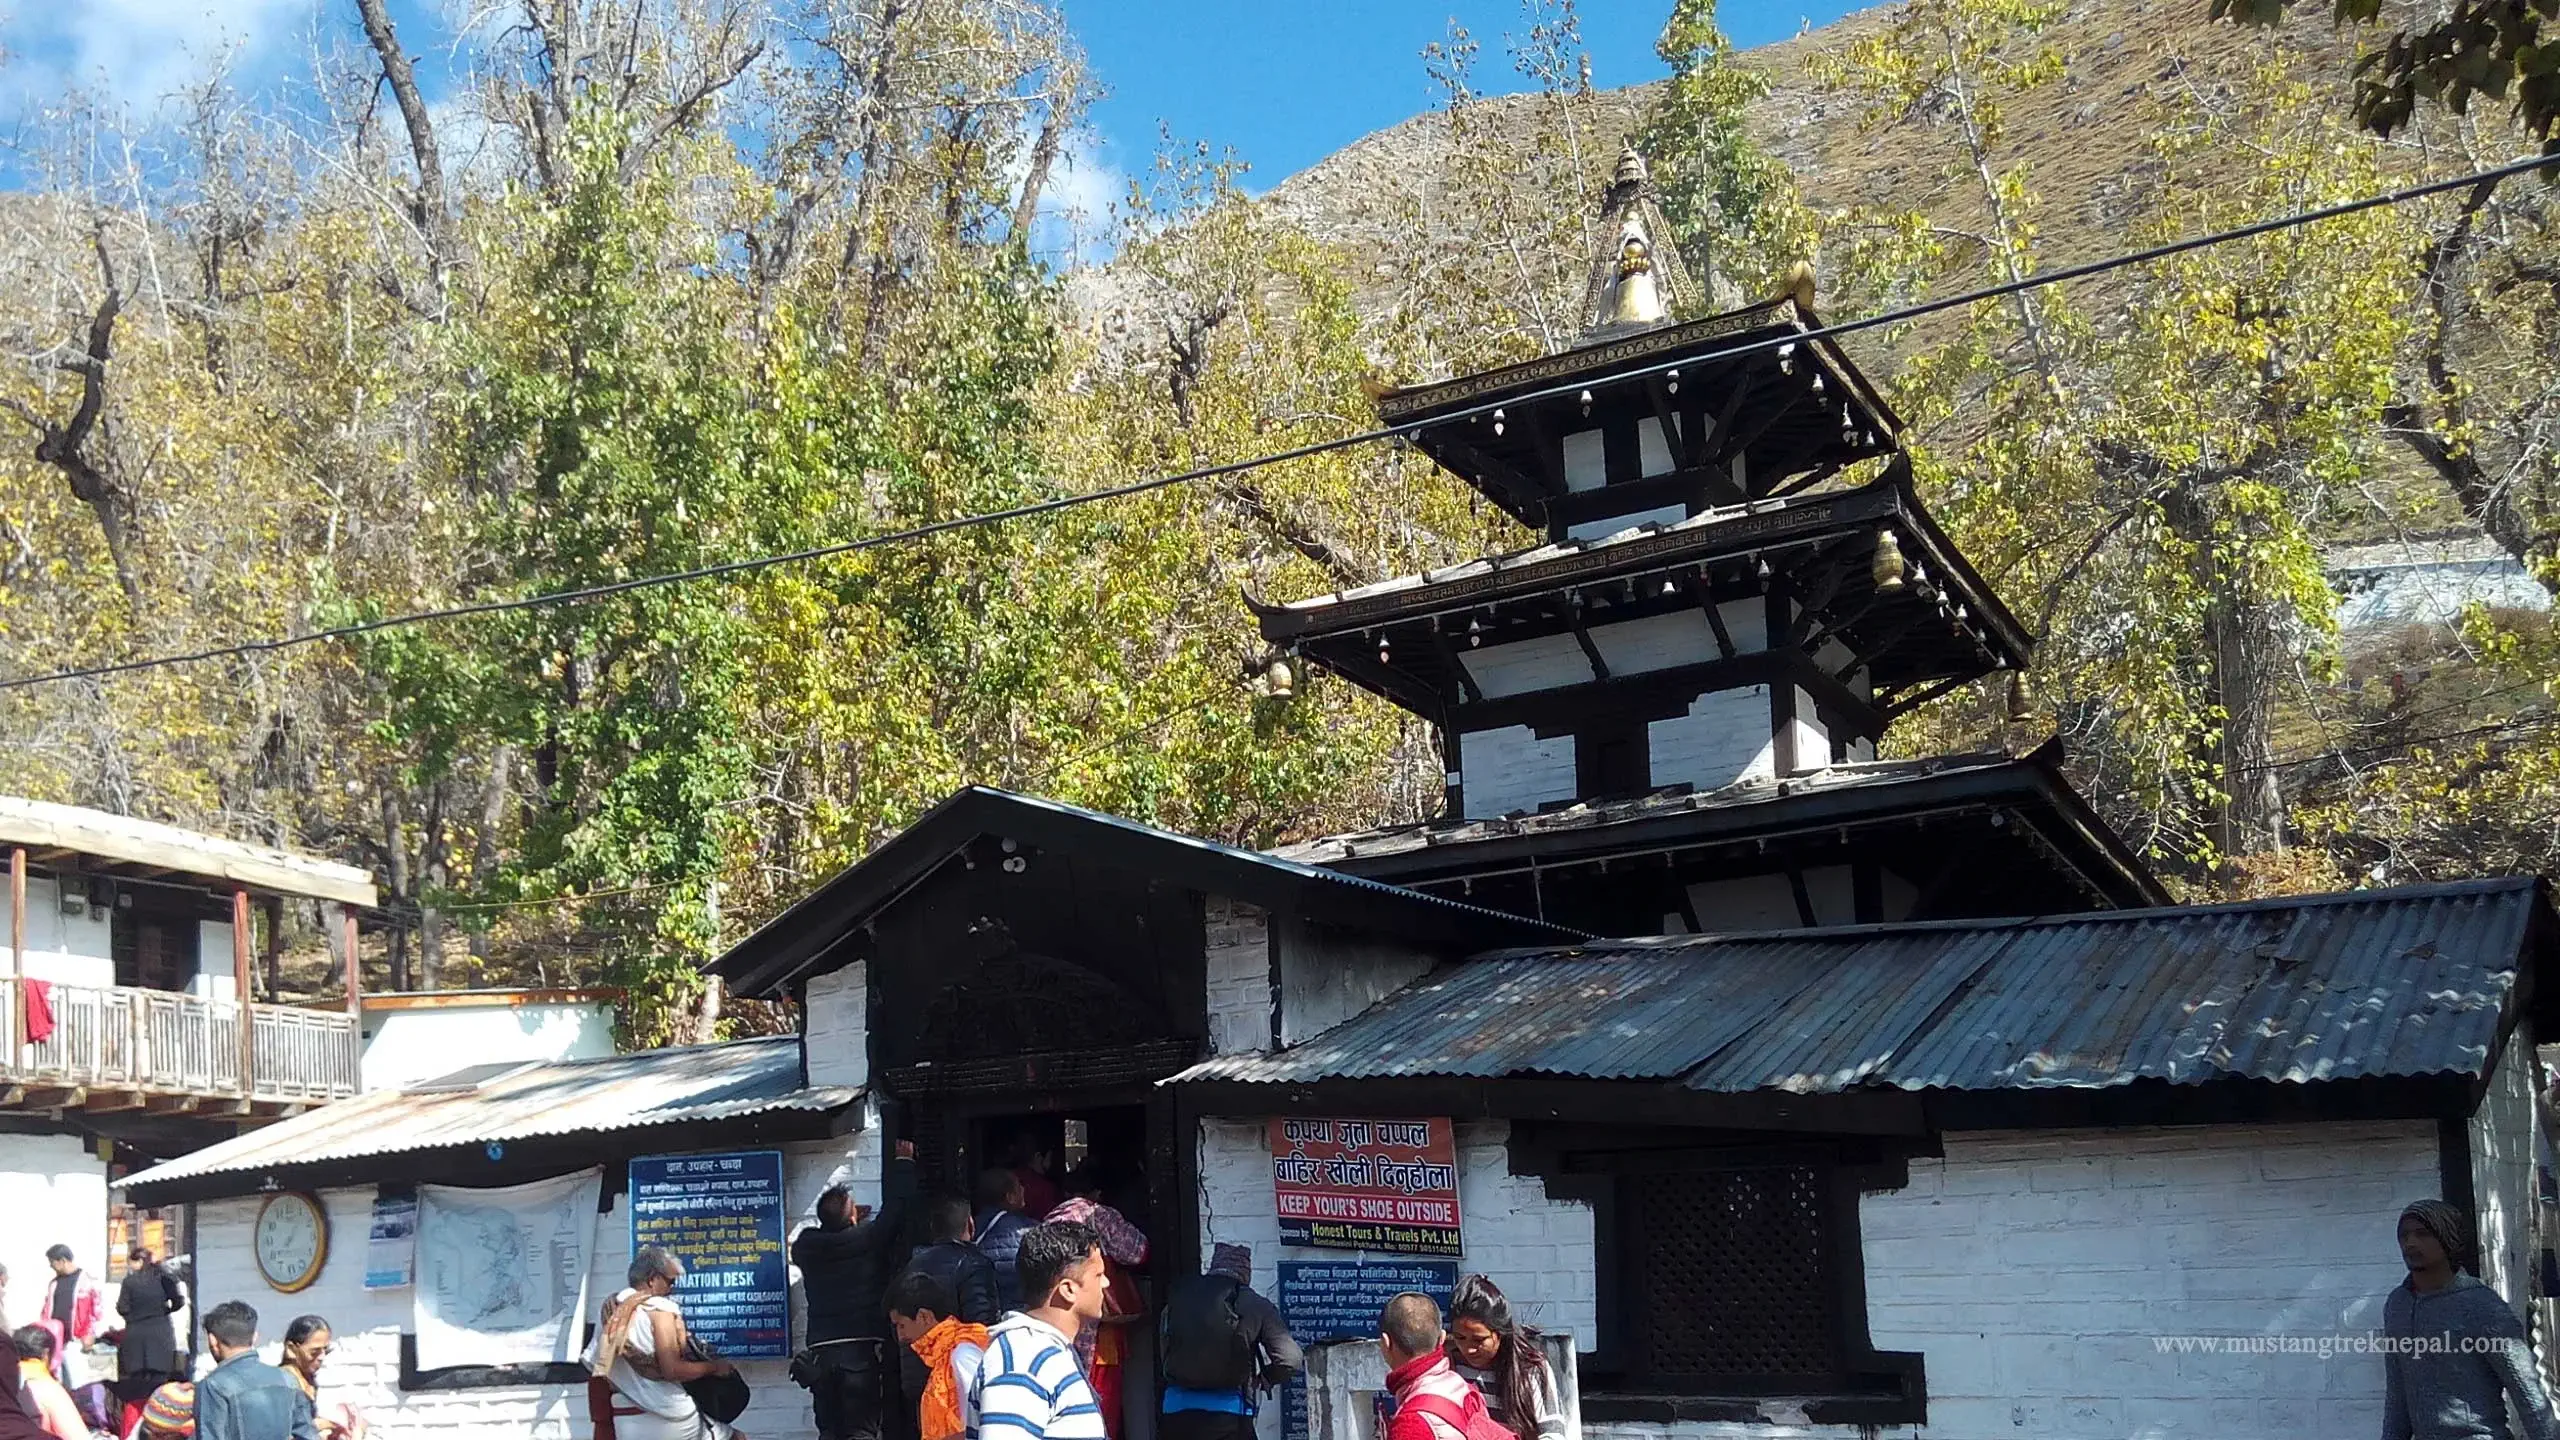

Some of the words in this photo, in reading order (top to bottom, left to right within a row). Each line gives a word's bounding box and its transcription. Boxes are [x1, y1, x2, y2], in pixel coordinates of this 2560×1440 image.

[1283, 1118, 1332, 1148] कृपया
[1336, 1120, 1372, 1149] जुता
[1275, 1150, 1321, 1184] बाहिर
[1325, 1152, 1372, 1186] खोली
[1376, 1154, 1452, 1195] दिनुहोला
[1279, 1194, 1309, 1214] KEEP
[1313, 1197, 1357, 1217] YOUR'S
[1360, 1199, 1394, 1220] SHOE
[1397, 1201, 1452, 1223] OUTSIDE
[1312, 1222, 1345, 1238] Honest
[1346, 1225, 1372, 1240] Tours
[1375, 1226, 1382, 1240] &
[1384, 1227, 1419, 1243] Travels
[1421, 1229, 1440, 1244] Pvt.
[1442, 1230, 1459, 1245] Ltd
[723, 1271, 755, 1287] DESK
